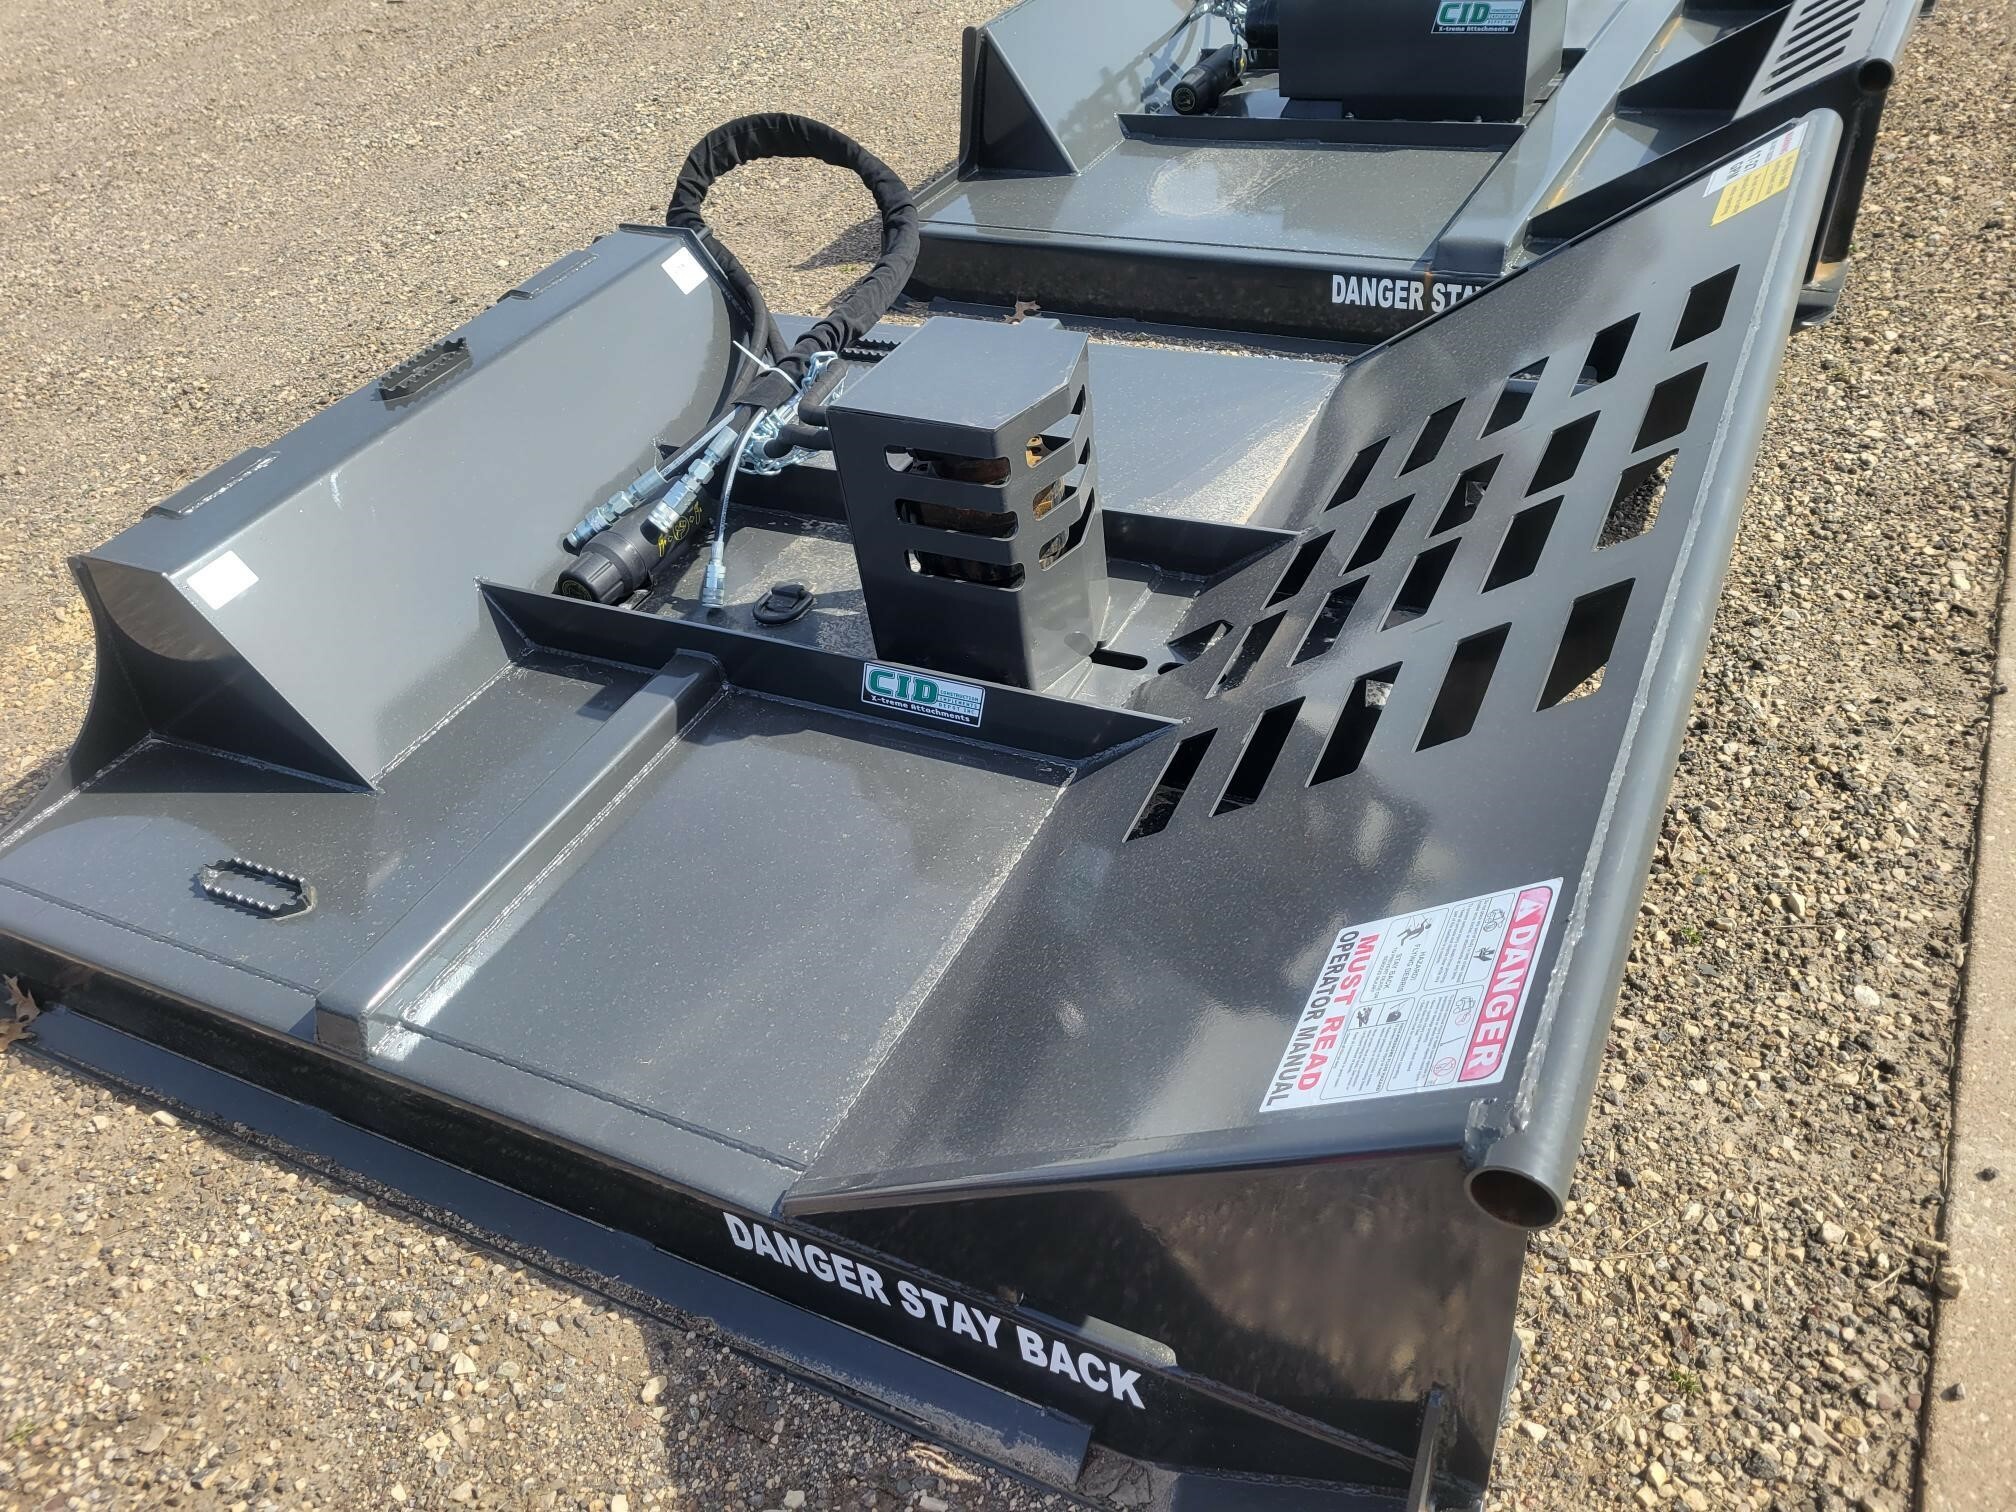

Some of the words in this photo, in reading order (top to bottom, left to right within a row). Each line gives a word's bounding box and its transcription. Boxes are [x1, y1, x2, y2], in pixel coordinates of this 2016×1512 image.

[1439, 3, 1490, 24] CID
[1332, 274, 1424, 311] DANGER
[1431, 282, 1482, 312] ST
[869, 668, 939, 705] CID
[870, 695, 909, 709] X-treme
[910, 704, 970, 722] Attachments
[1303, 929, 1360, 1021] OPERATOR
[1331, 933, 1379, 1008] MUST
[1466, 923, 1538, 1069] DANGER
[1265, 1025, 1318, 1106] MANUAL
[1294, 1015, 1345, 1092] READ
[722, 1212, 892, 1306] DANGER
[897, 1280, 1001, 1348] STAY
[1016, 1325, 1146, 1410] BACK
